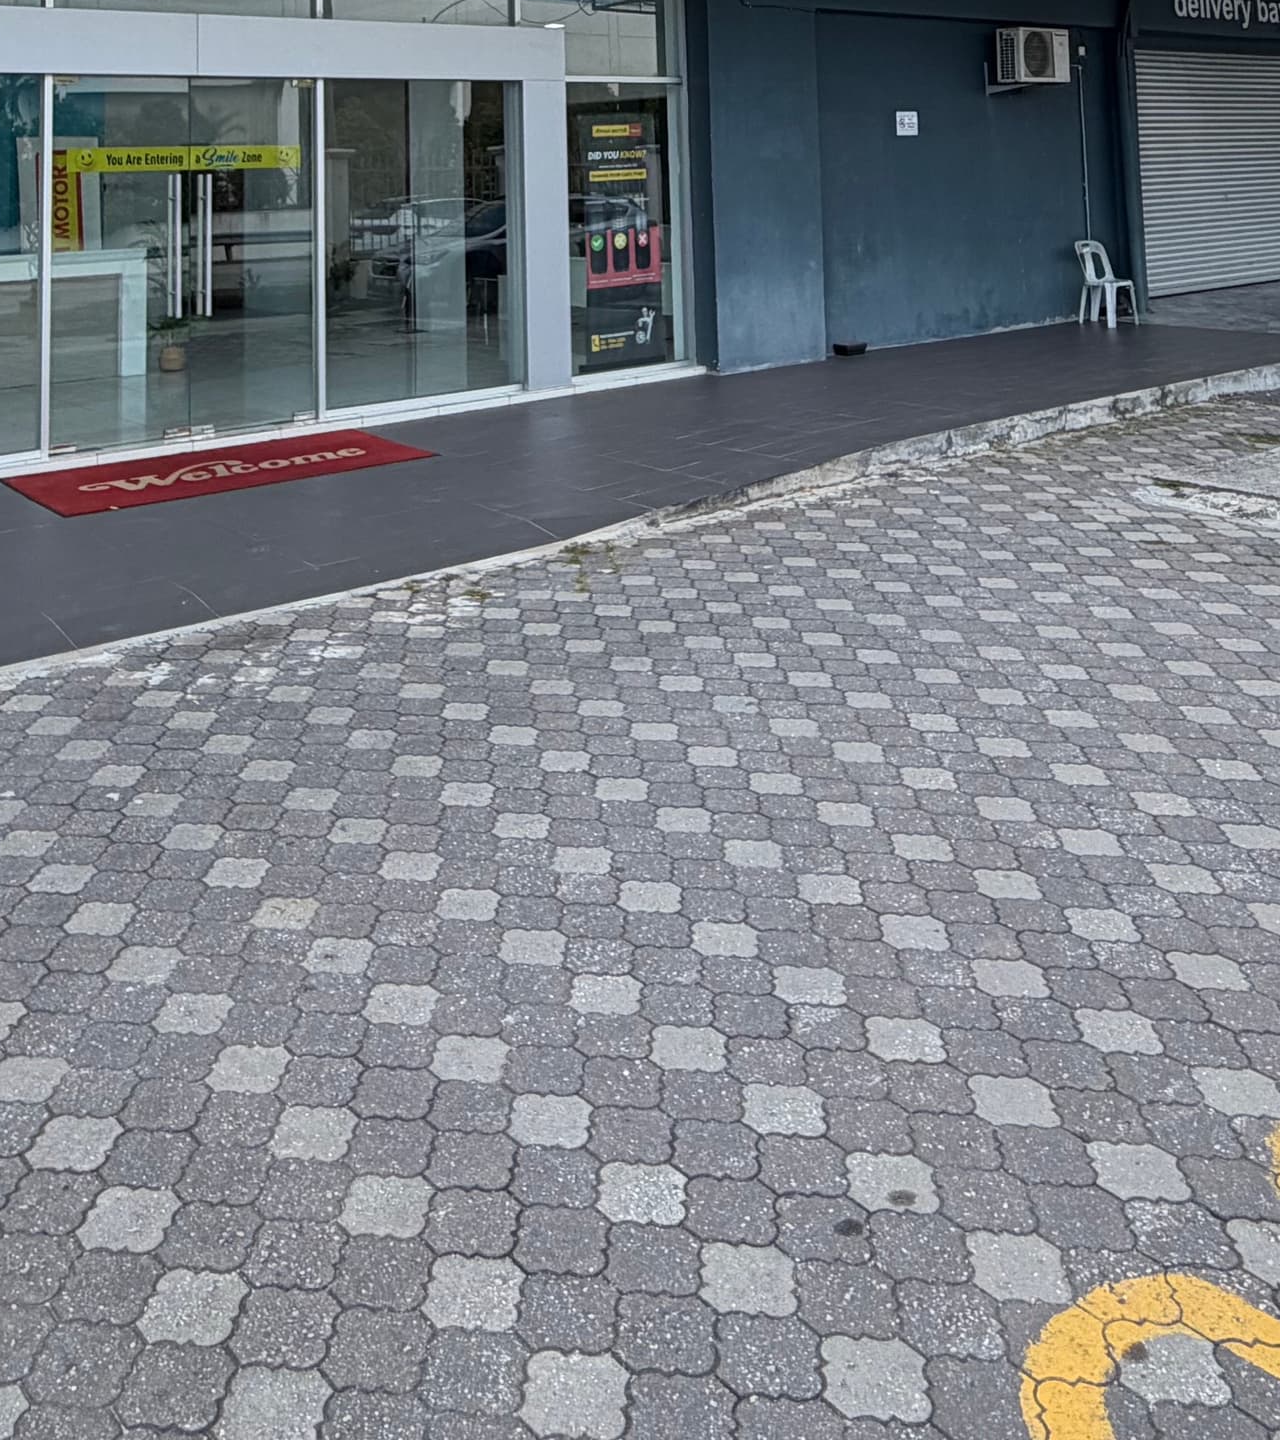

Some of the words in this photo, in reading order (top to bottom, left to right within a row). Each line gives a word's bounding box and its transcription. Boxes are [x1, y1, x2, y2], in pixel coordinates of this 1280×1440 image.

[106, 153, 124, 166] You
[125, 153, 142, 166] Are
[145, 153, 184, 167] Entering
[195, 155, 201, 164] a
[201, 147, 240, 167] Smile
[241, 152, 263, 164] Zone
[587, 151, 602, 161] DID
[603, 150, 619, 160] YOU
[53, 165, 70, 240] MOTOR
[77, 446, 367, 492] Welcome
